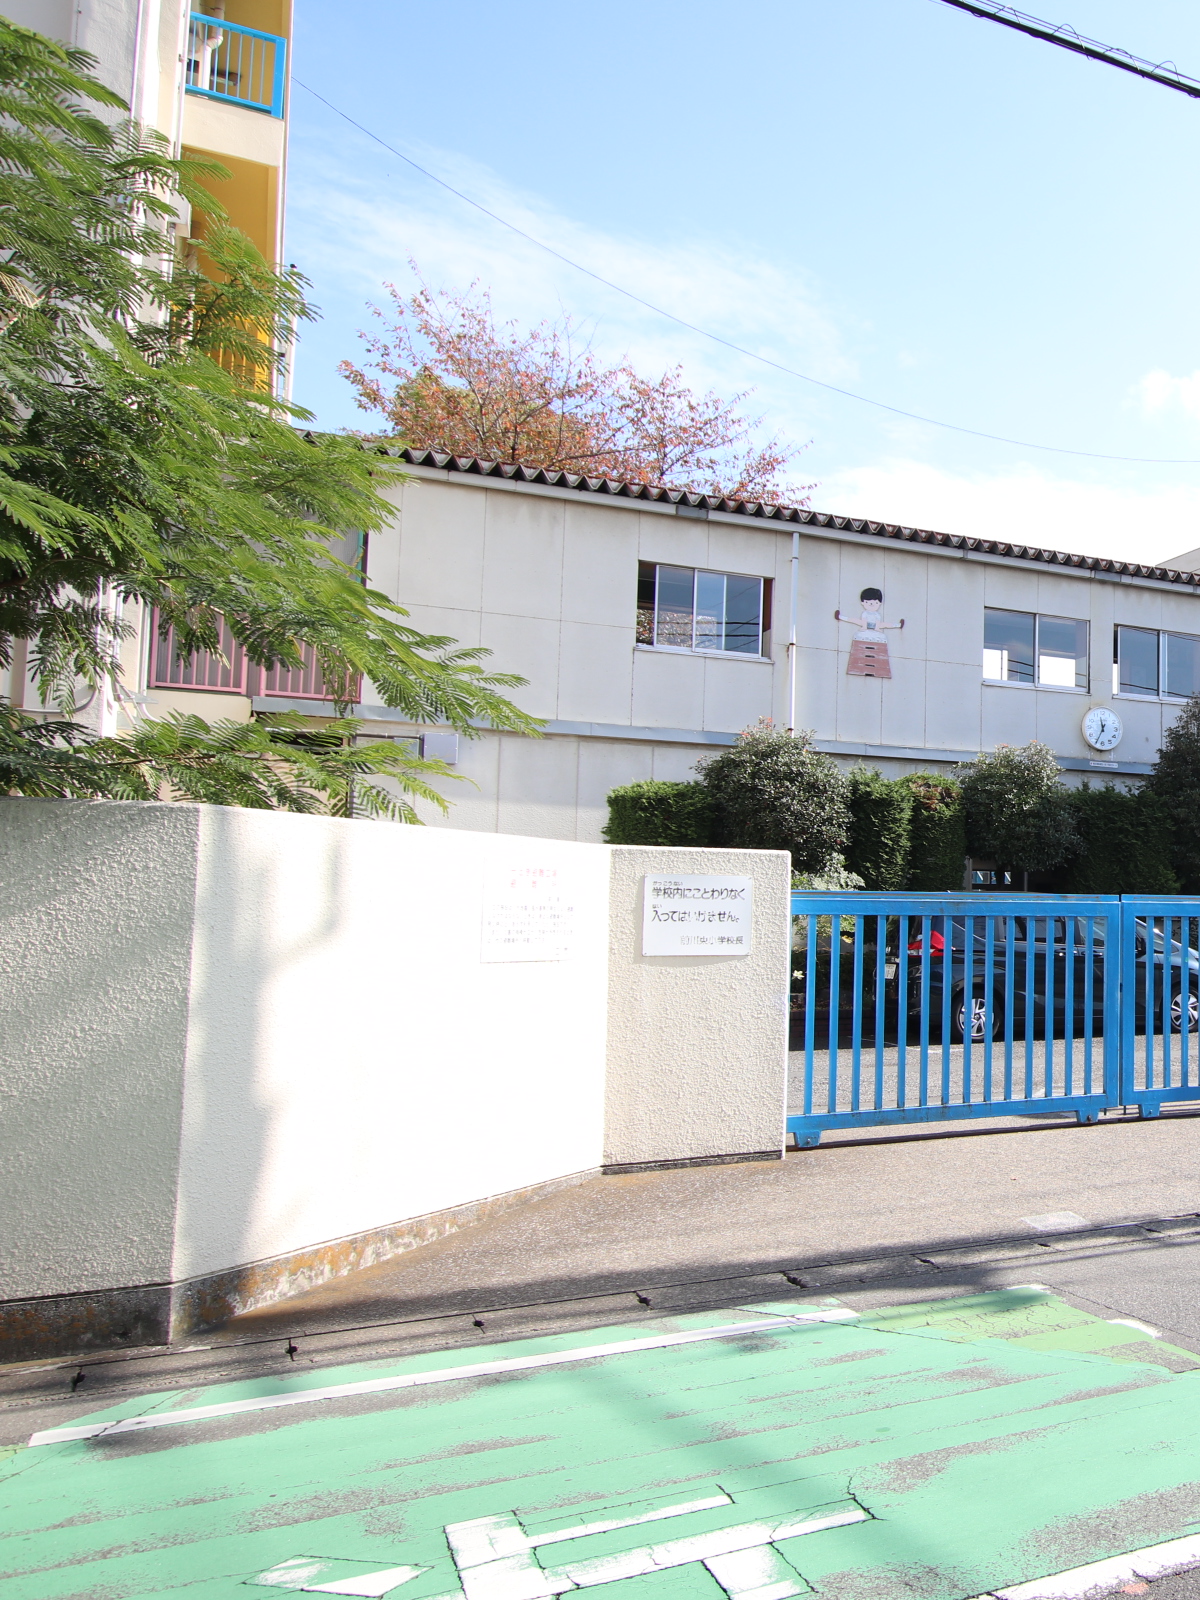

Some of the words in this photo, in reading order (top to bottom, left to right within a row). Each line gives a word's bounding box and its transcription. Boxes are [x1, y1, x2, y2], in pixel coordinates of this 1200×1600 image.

[651, 887, 746, 900] 学校内にことわりなく
[651, 909, 740, 923] 入ってはいけません。
